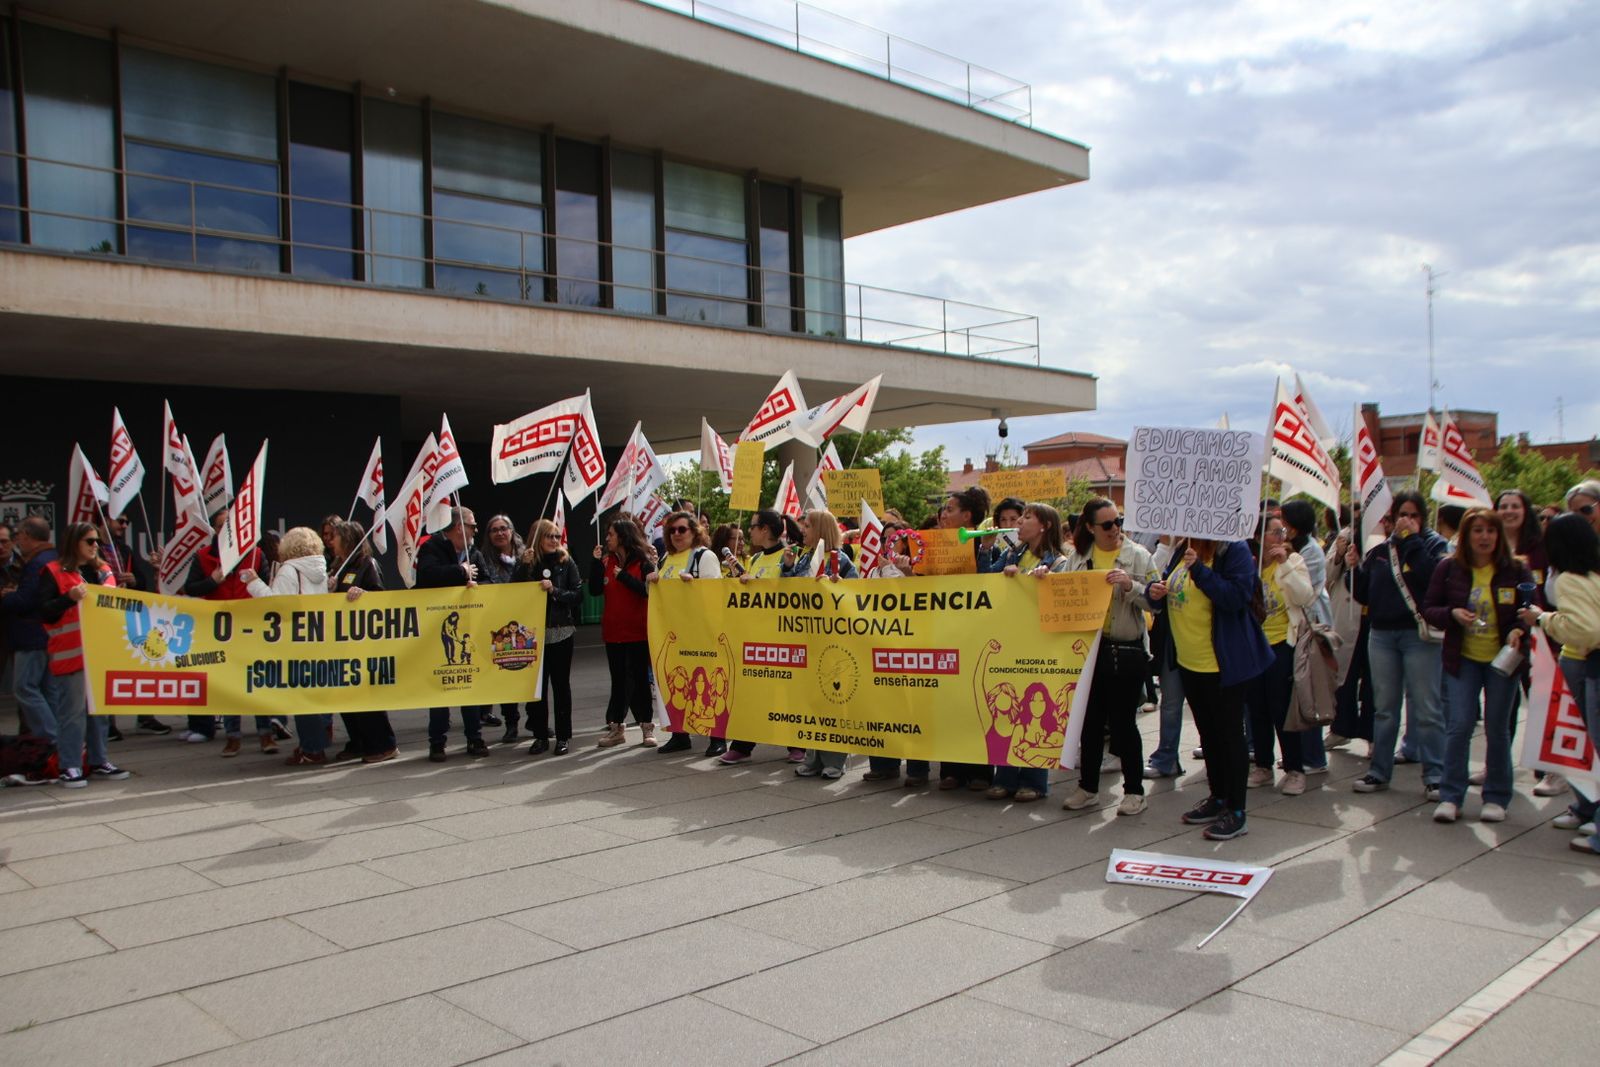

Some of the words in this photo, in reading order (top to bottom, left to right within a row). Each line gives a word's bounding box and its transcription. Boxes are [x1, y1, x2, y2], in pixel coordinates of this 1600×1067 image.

[504, 418, 575, 453] CCOO
[751, 420, 791, 442] alamanca
[1135, 428, 1252, 457] EDUCAMOS
[1142, 455, 1186, 480] CON
[1194, 458, 1252, 485] AMOR
[1134, 479, 1243, 510] EXIGIMOS
[1136, 506, 1178, 531] CON
[97, 594, 143, 613] MALTRATO
[727, 592, 823, 610] ABANDONO
[831, 593, 845, 610] Y
[856, 590, 992, 612] VIOLENCIA
[263, 611, 281, 642] 3
[292, 610, 325, 642] EN
[335, 607, 420, 642] LUCHA
[778, 615, 914, 636] INSTITUCIONAL
[175, 651, 226, 669] SOLUCIONES
[744, 646, 790, 663] CCOO
[874, 652, 934, 669] CCOO
[1015, 658, 1045, 666] MEJORA
[247, 657, 361, 693] ¡SOLUCIONES
[367, 656, 396, 685] YA!
[442, 676, 455, 685] EN
[457, 675, 472, 684] PIE
[742, 667, 792, 679] enseñanza
[873, 675, 939, 688] enseñanza
[989, 667, 1039, 675] CONDICIONES
[112, 679, 200, 698] CCOO
[768, 712, 801, 724] SOMOS
[804, 715, 816, 725] LA
[819, 717, 837, 727] VOZ
[840, 718, 852, 729] DE
[853, 720, 865, 730] LA
[867, 721, 922, 734] INFANCIA
[798, 731, 812, 741] 0-3
[815, 733, 827, 742] ES
[829, 734, 885, 749] EDUCACIÓN
[1121, 862, 1242, 883] CCOO
